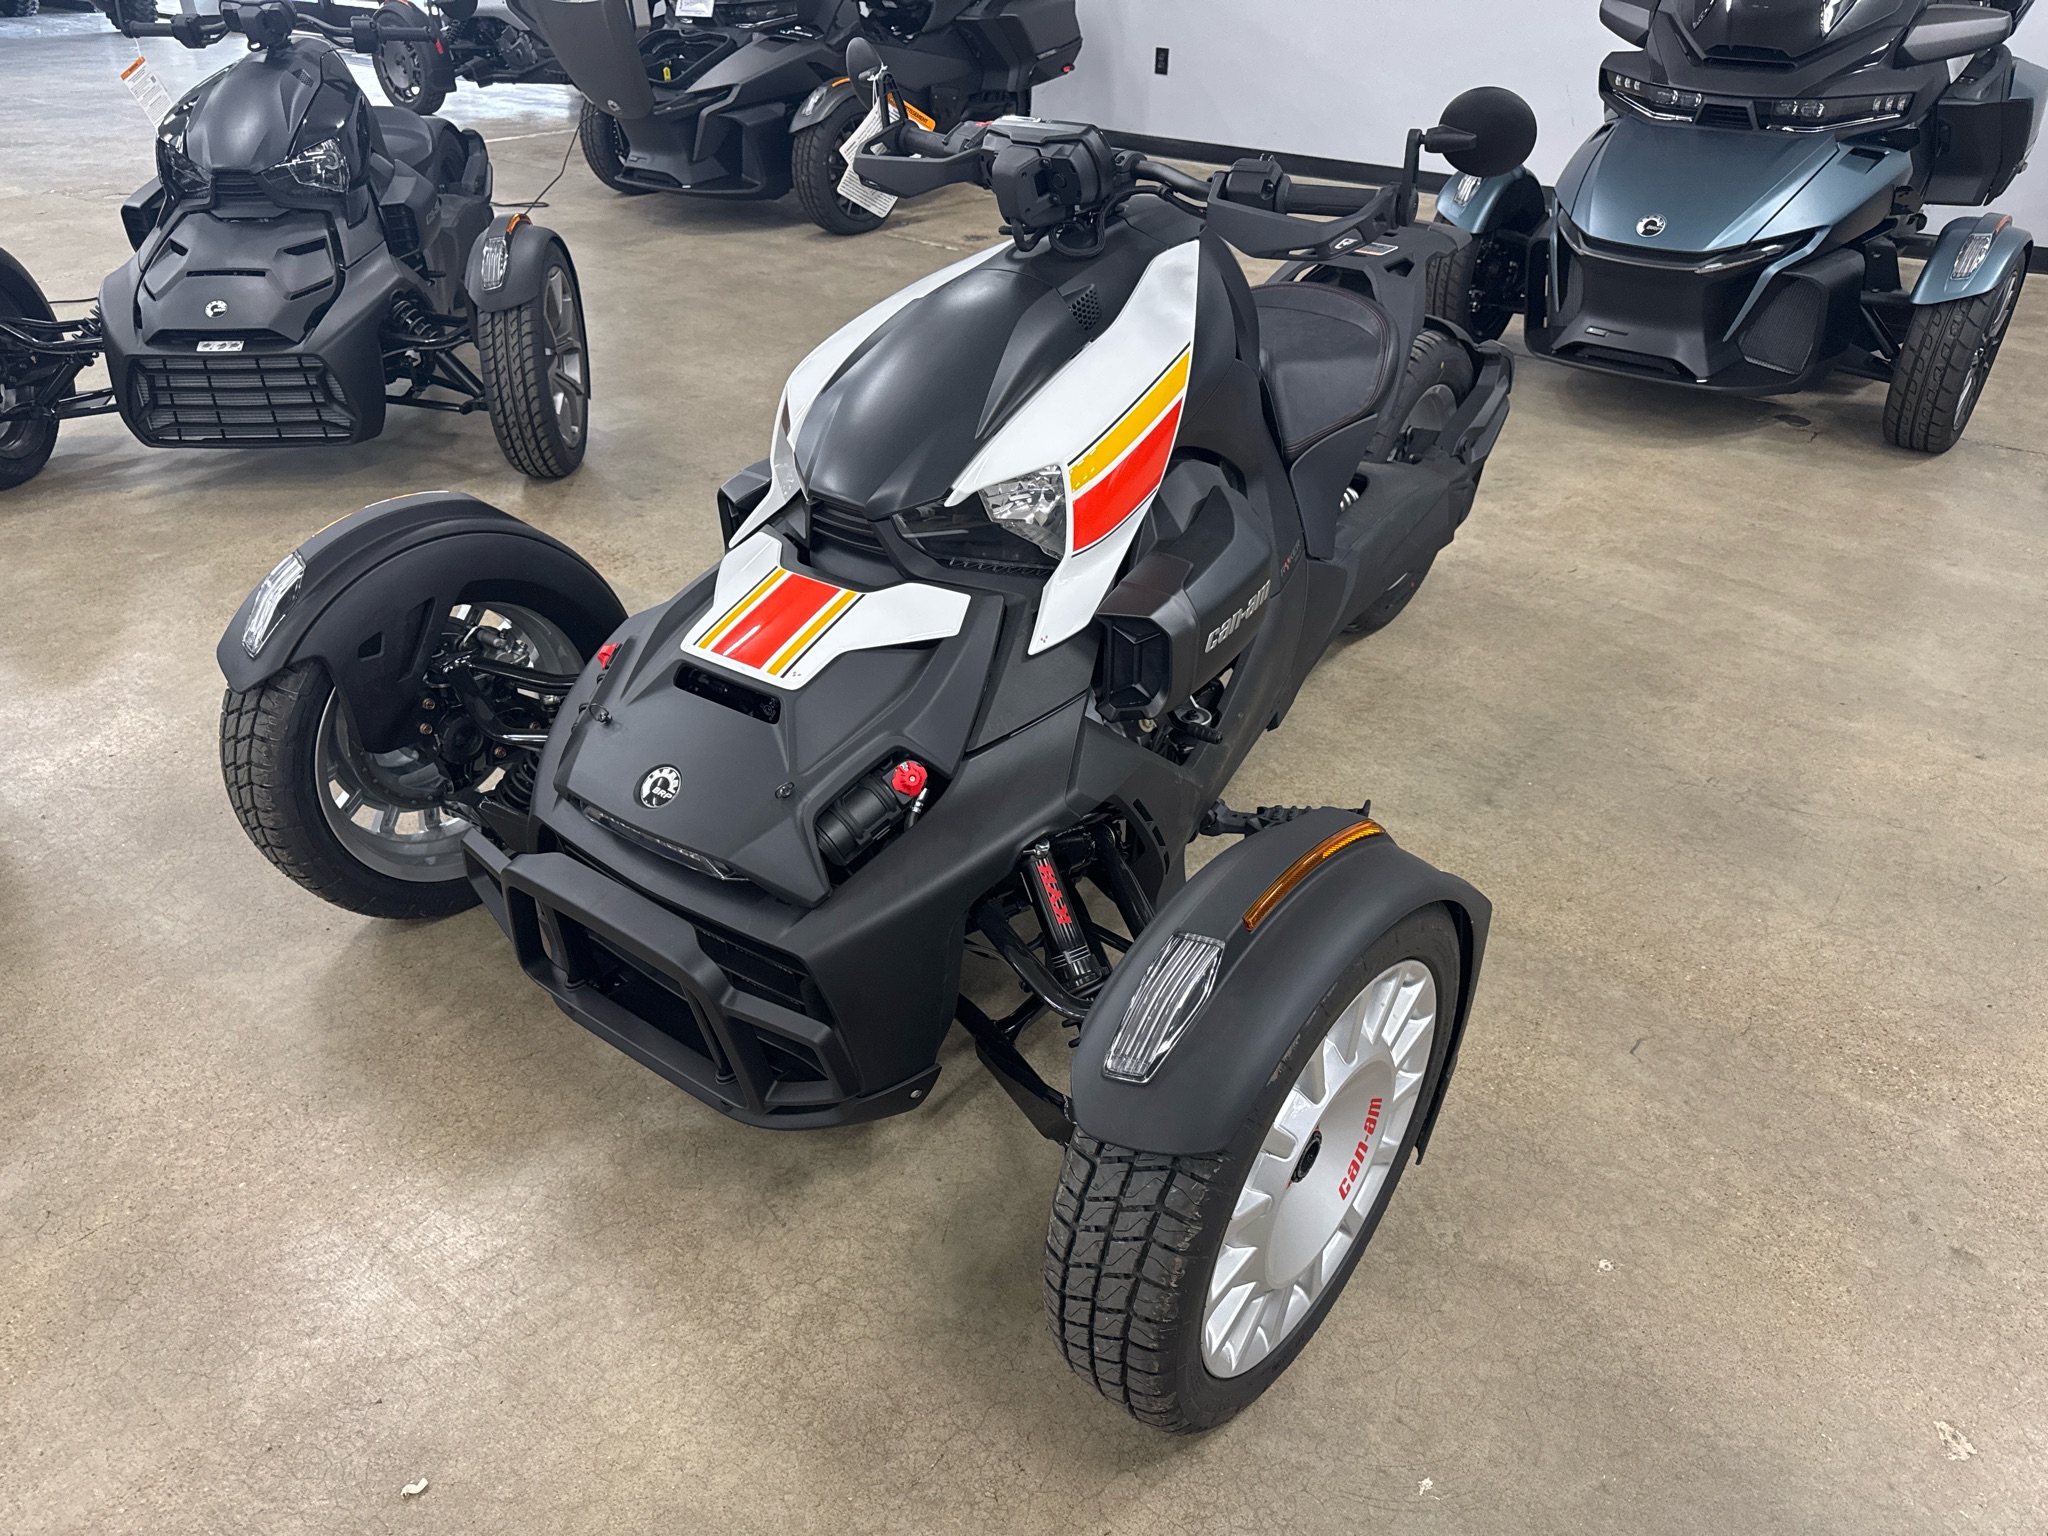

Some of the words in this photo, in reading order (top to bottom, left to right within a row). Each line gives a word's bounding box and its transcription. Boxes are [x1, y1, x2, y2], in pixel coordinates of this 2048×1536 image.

[1204, 579, 1271, 653] can-am
[651, 786, 673, 799] BRP
[1037, 864, 1072, 924] KYB
[1338, 1098, 1382, 1200] can-am
